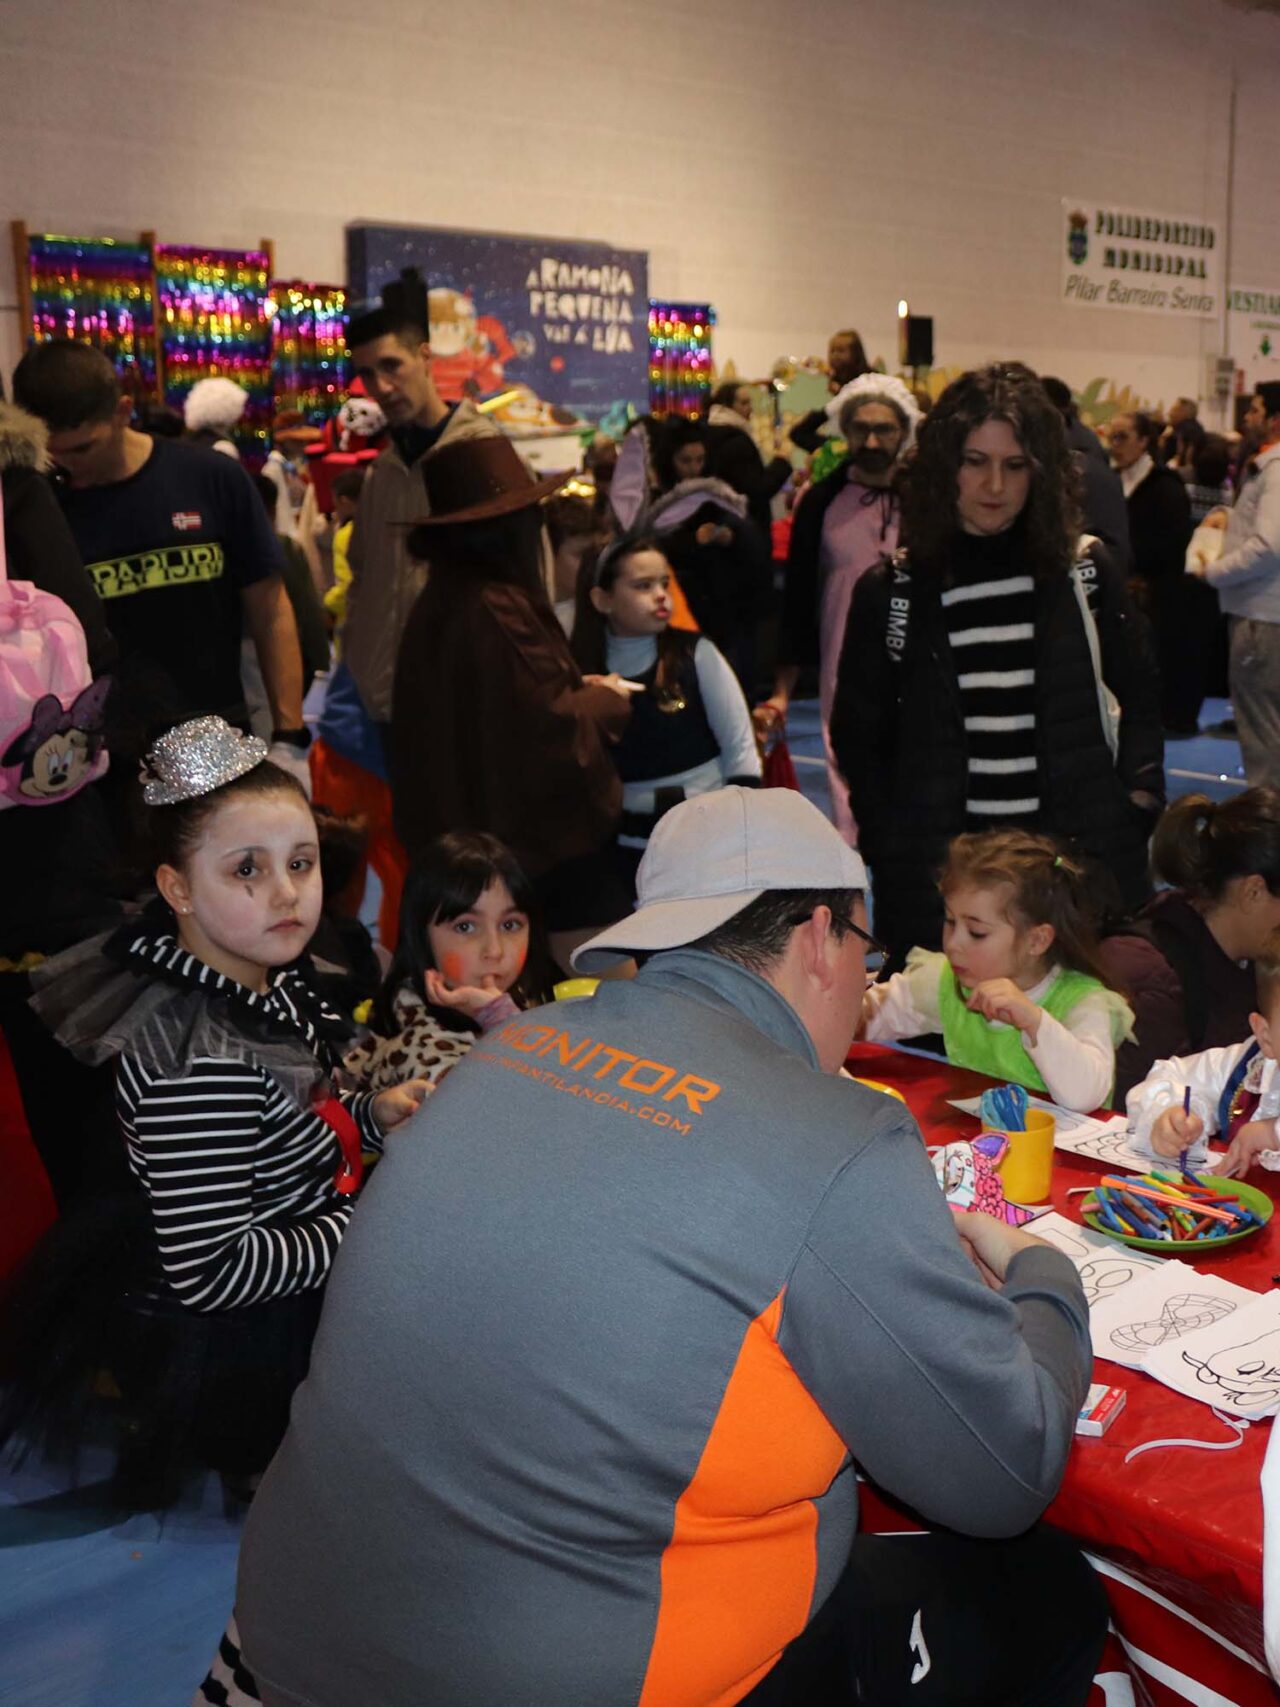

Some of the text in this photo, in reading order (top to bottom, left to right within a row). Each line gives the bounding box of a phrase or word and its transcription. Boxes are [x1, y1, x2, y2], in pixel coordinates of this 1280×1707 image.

[1095, 210, 1216, 251] POLIDEPORTIVO
[1103, 245, 1208, 280] MUNICIPAL
[1064, 273, 1104, 302] Pilar
[1107, 278, 1168, 308] Barreiro
[486, 1022, 722, 1116] MONITOR
